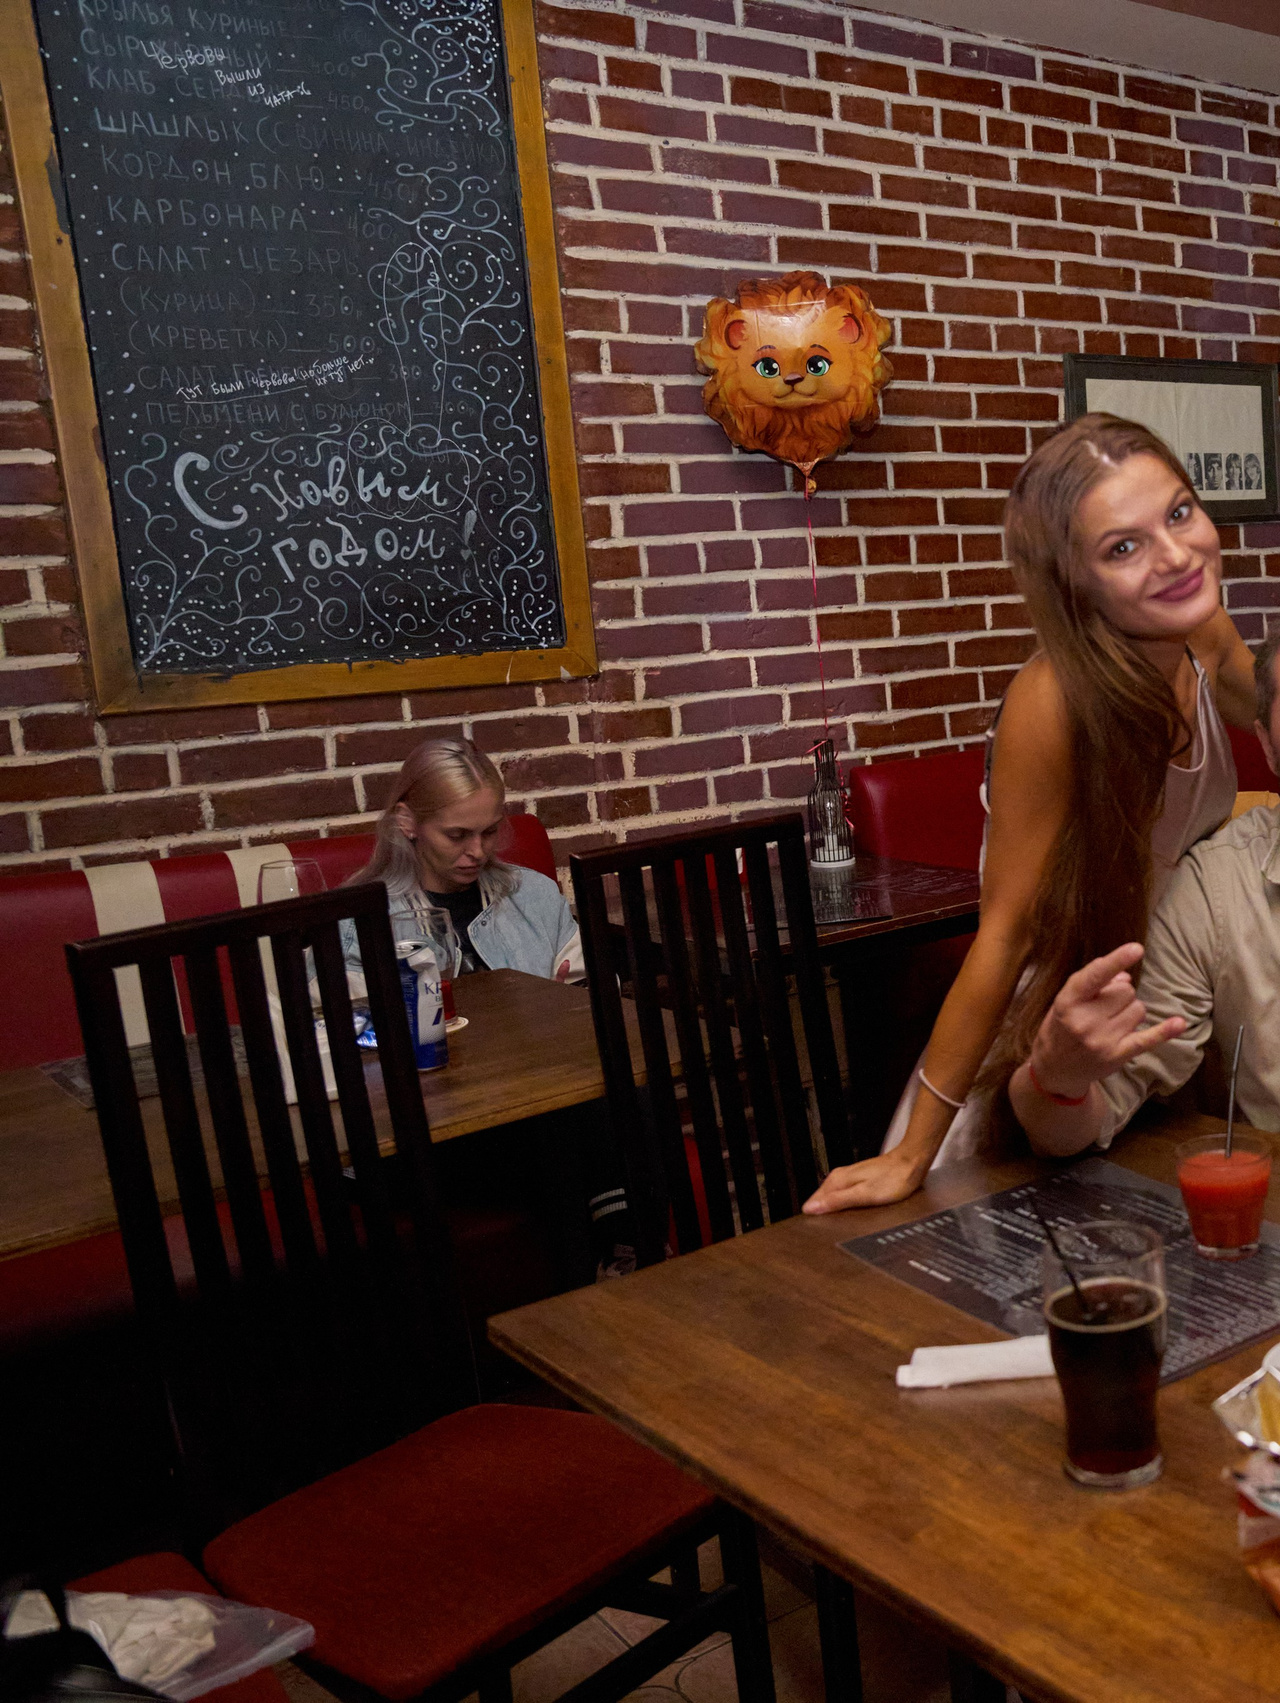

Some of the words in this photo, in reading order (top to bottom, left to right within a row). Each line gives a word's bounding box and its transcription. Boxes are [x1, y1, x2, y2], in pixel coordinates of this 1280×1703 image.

[87, 63, 157, 96] КЛАБ
[94, 106, 250, 144] ШАШЛЫК
[101, 145, 232, 186] КОРДОН
[249, 162, 325, 192] БЛЮ
[106, 195, 308, 232] КАРБОНАРА
[111, 242, 211, 274] САЛАТ
[237, 244, 359, 275] ЦЕЗАРЬ
[137, 364, 217, 391] САЛАТ
[145, 401, 281, 425] ПЕЛЬМЕНИ
[174, 451, 248, 529] С
